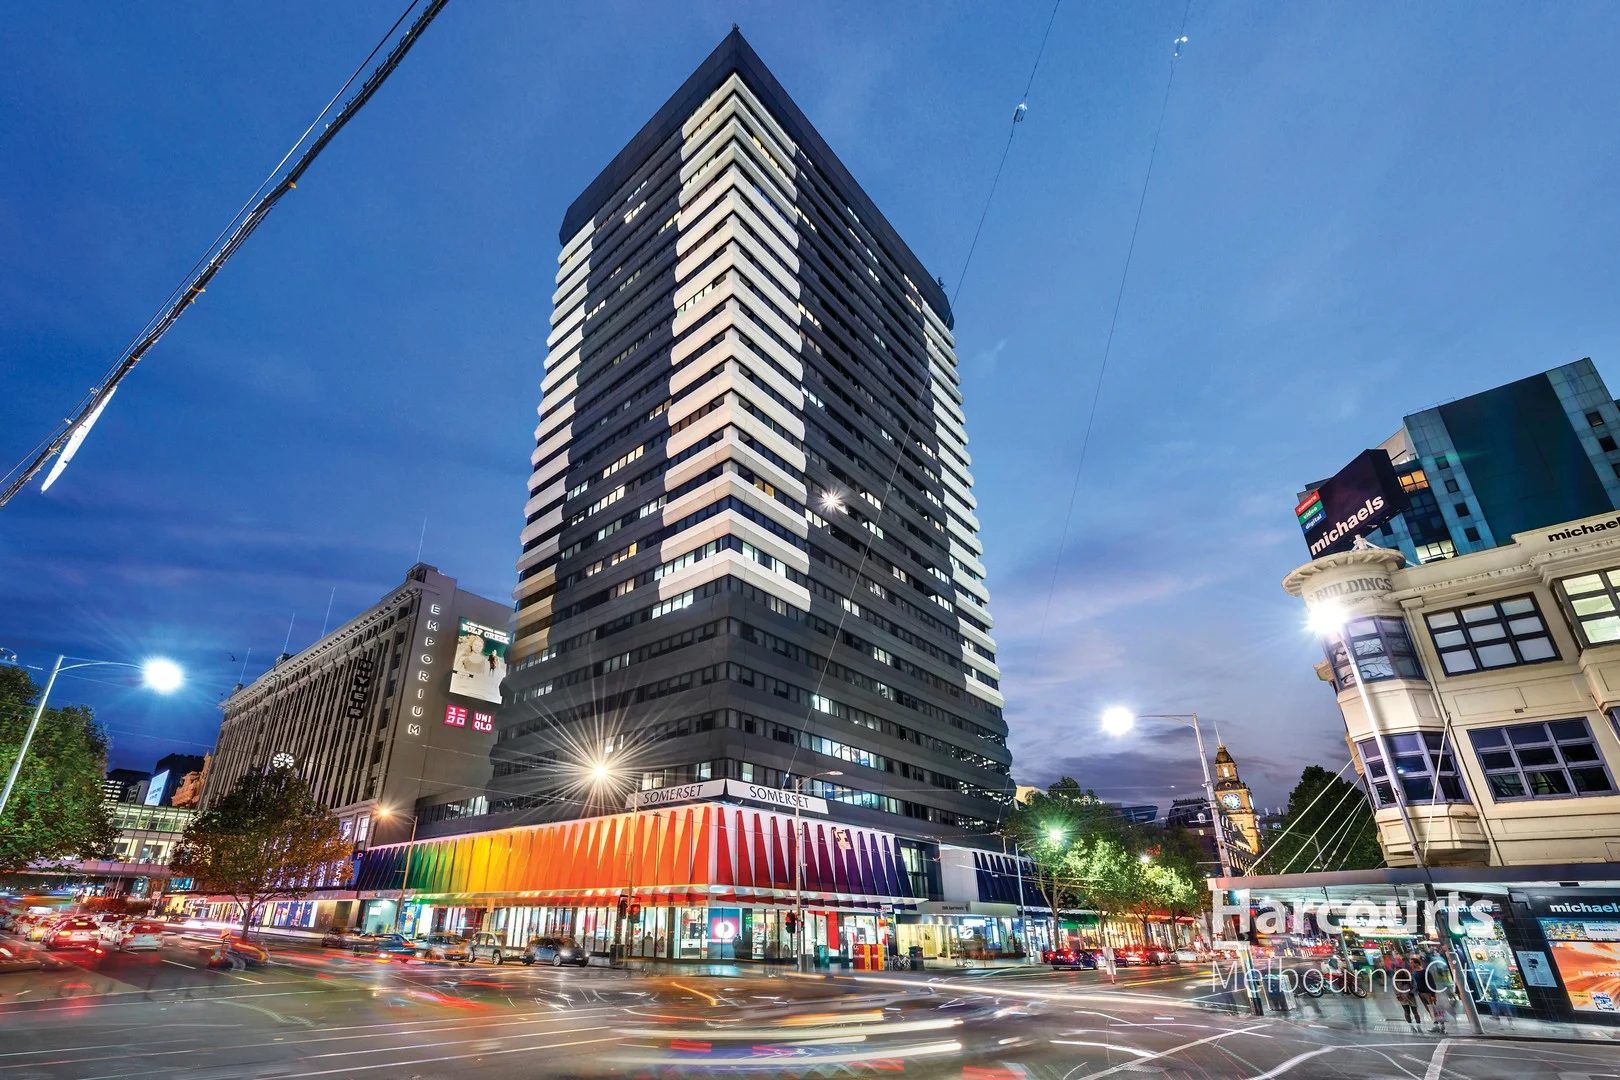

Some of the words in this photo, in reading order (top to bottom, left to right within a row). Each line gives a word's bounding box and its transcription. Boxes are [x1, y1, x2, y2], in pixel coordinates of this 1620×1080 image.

[1297, 494, 1317, 512] camera
[1302, 506, 1318, 520] video
[1305, 513, 1322, 530] digital
[1310, 495, 1385, 556] michaels
[1315, 577, 1393, 601] BUILDINGS
[408, 604, 441, 736] EMPORIUM
[349, 660, 372, 717] MYER
[643, 784, 703, 804] SOMERSET
[749, 785, 809, 808] SOMERSET
